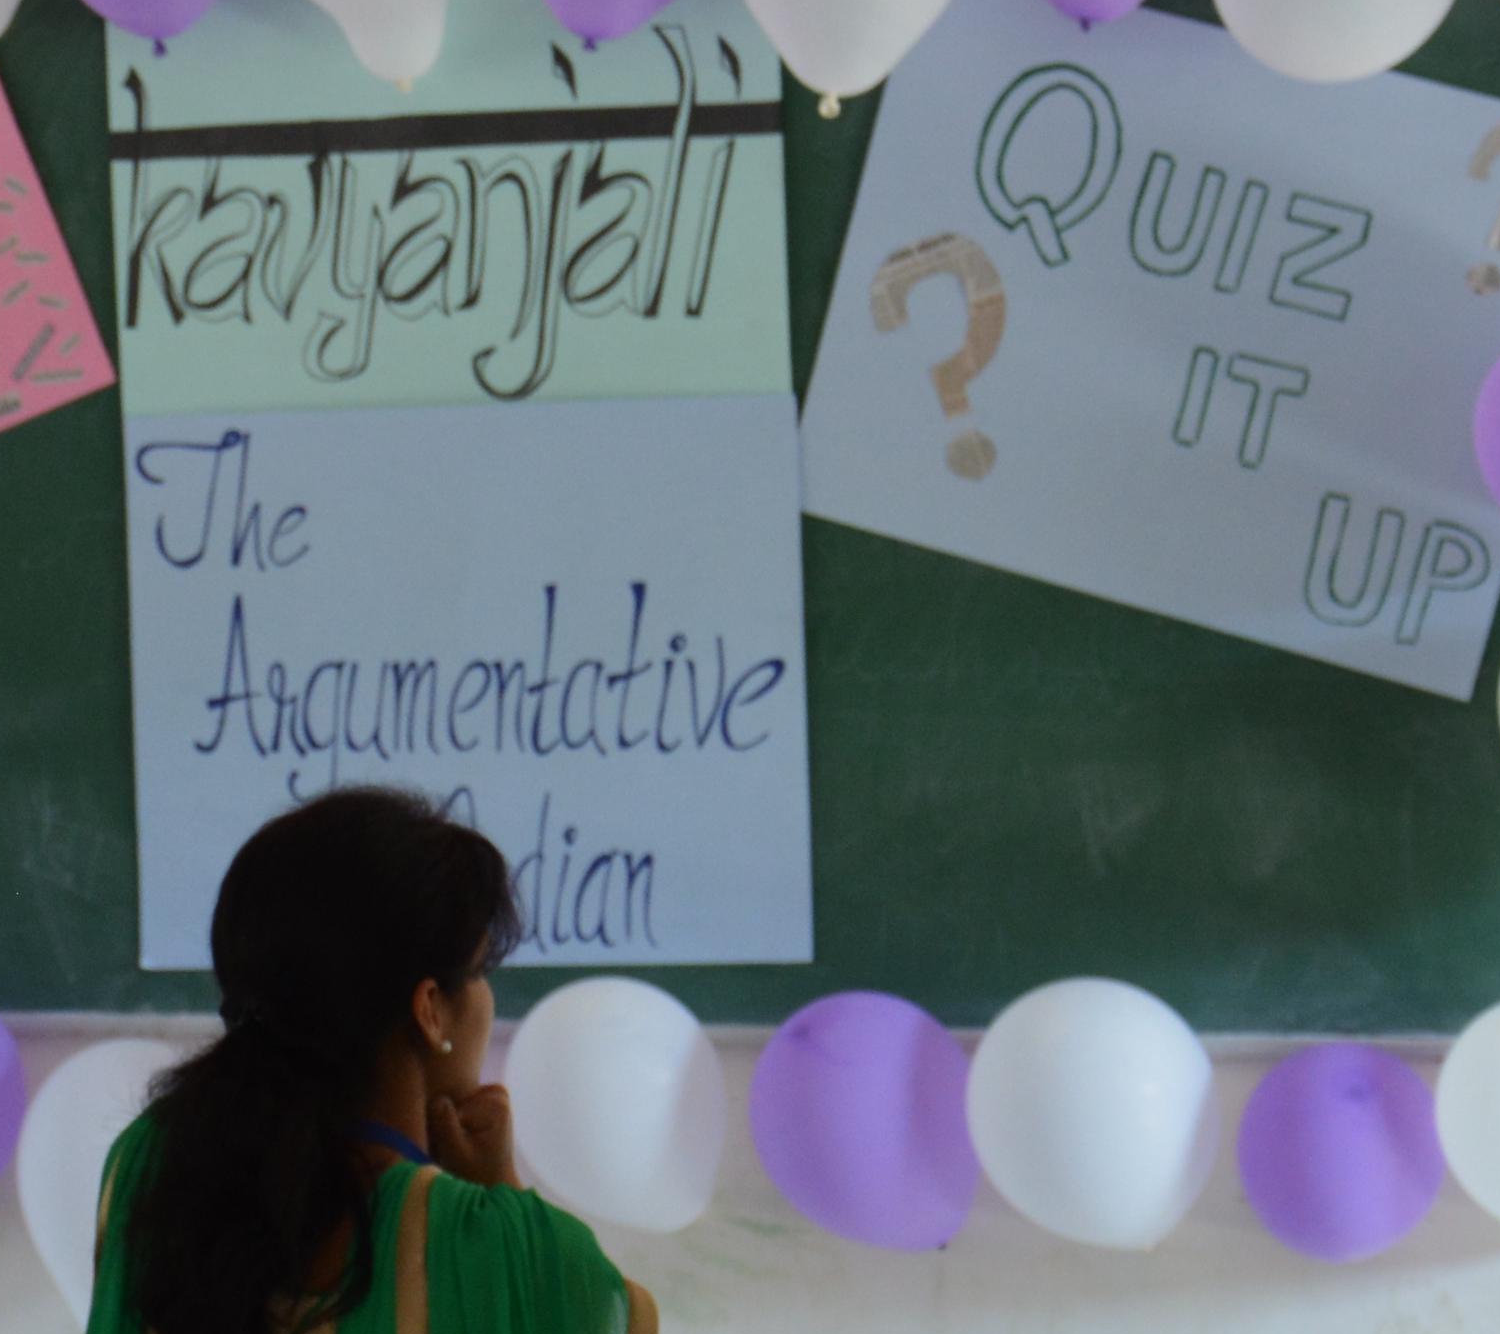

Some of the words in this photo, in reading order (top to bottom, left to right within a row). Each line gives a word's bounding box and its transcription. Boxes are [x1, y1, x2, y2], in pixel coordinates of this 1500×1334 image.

[975, 62, 1373, 322] QUIZ
[1172, 346, 1310, 470] IT
[135, 428, 310, 571] The
[1303, 492, 1491, 645] UP
[194, 580, 788, 787] Argumentative
[438, 784, 657, 955] dian
